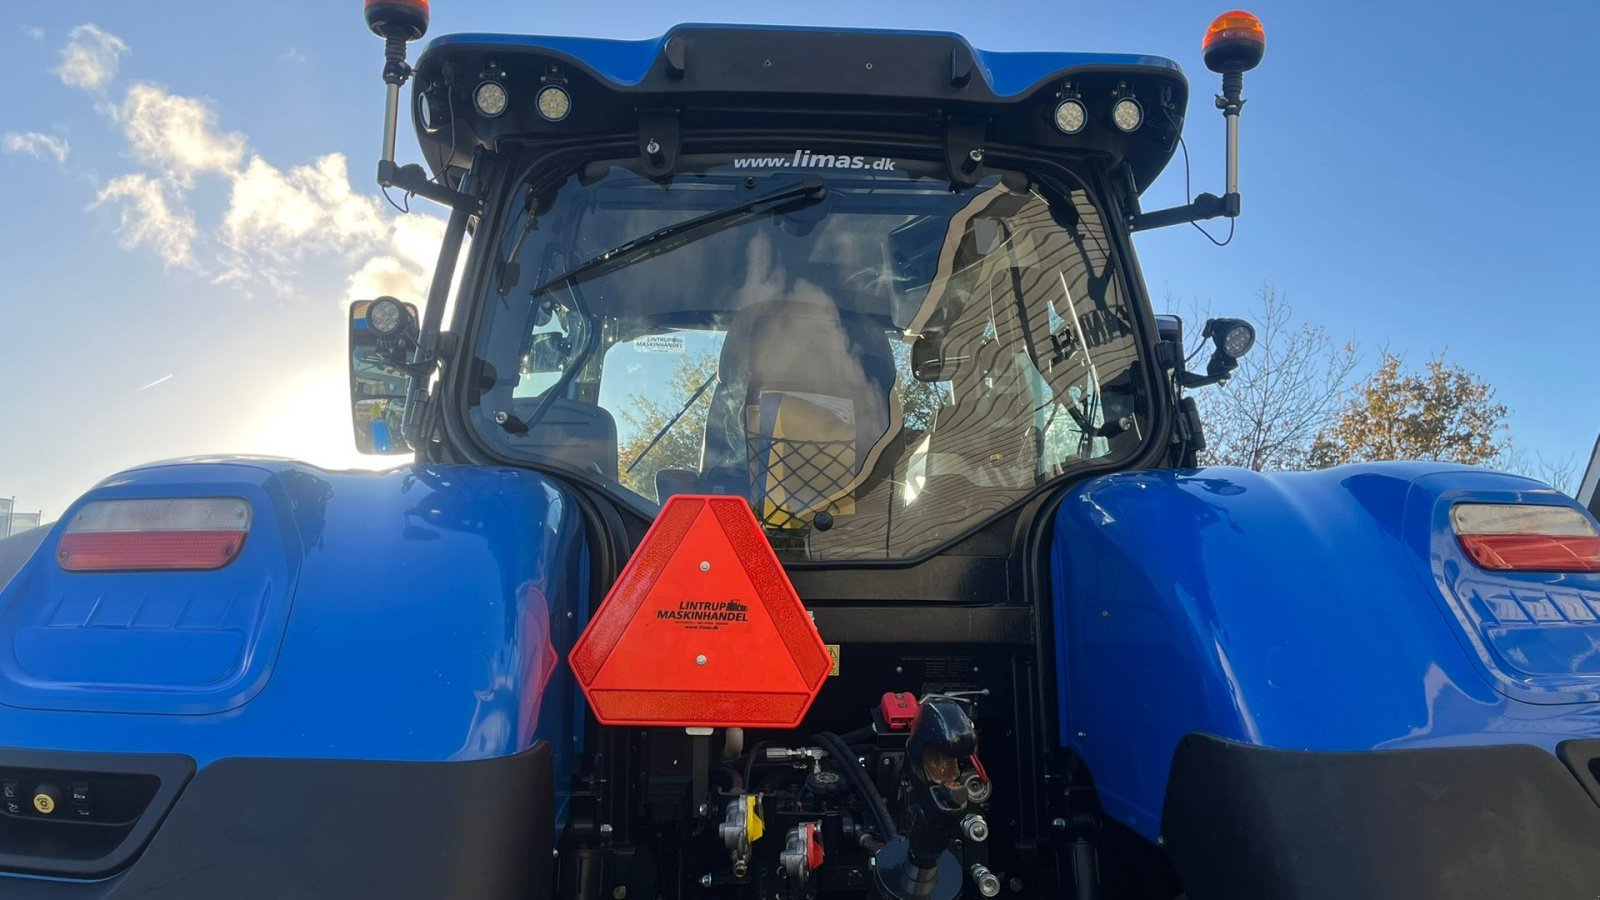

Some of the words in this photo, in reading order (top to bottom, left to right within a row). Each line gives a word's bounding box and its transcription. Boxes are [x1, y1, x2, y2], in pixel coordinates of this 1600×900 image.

[734, 150, 895, 170] www.limas.dk
[679, 601, 726, 611] LINTRUP
[657, 610, 748, 622] MASKINHANDEL
